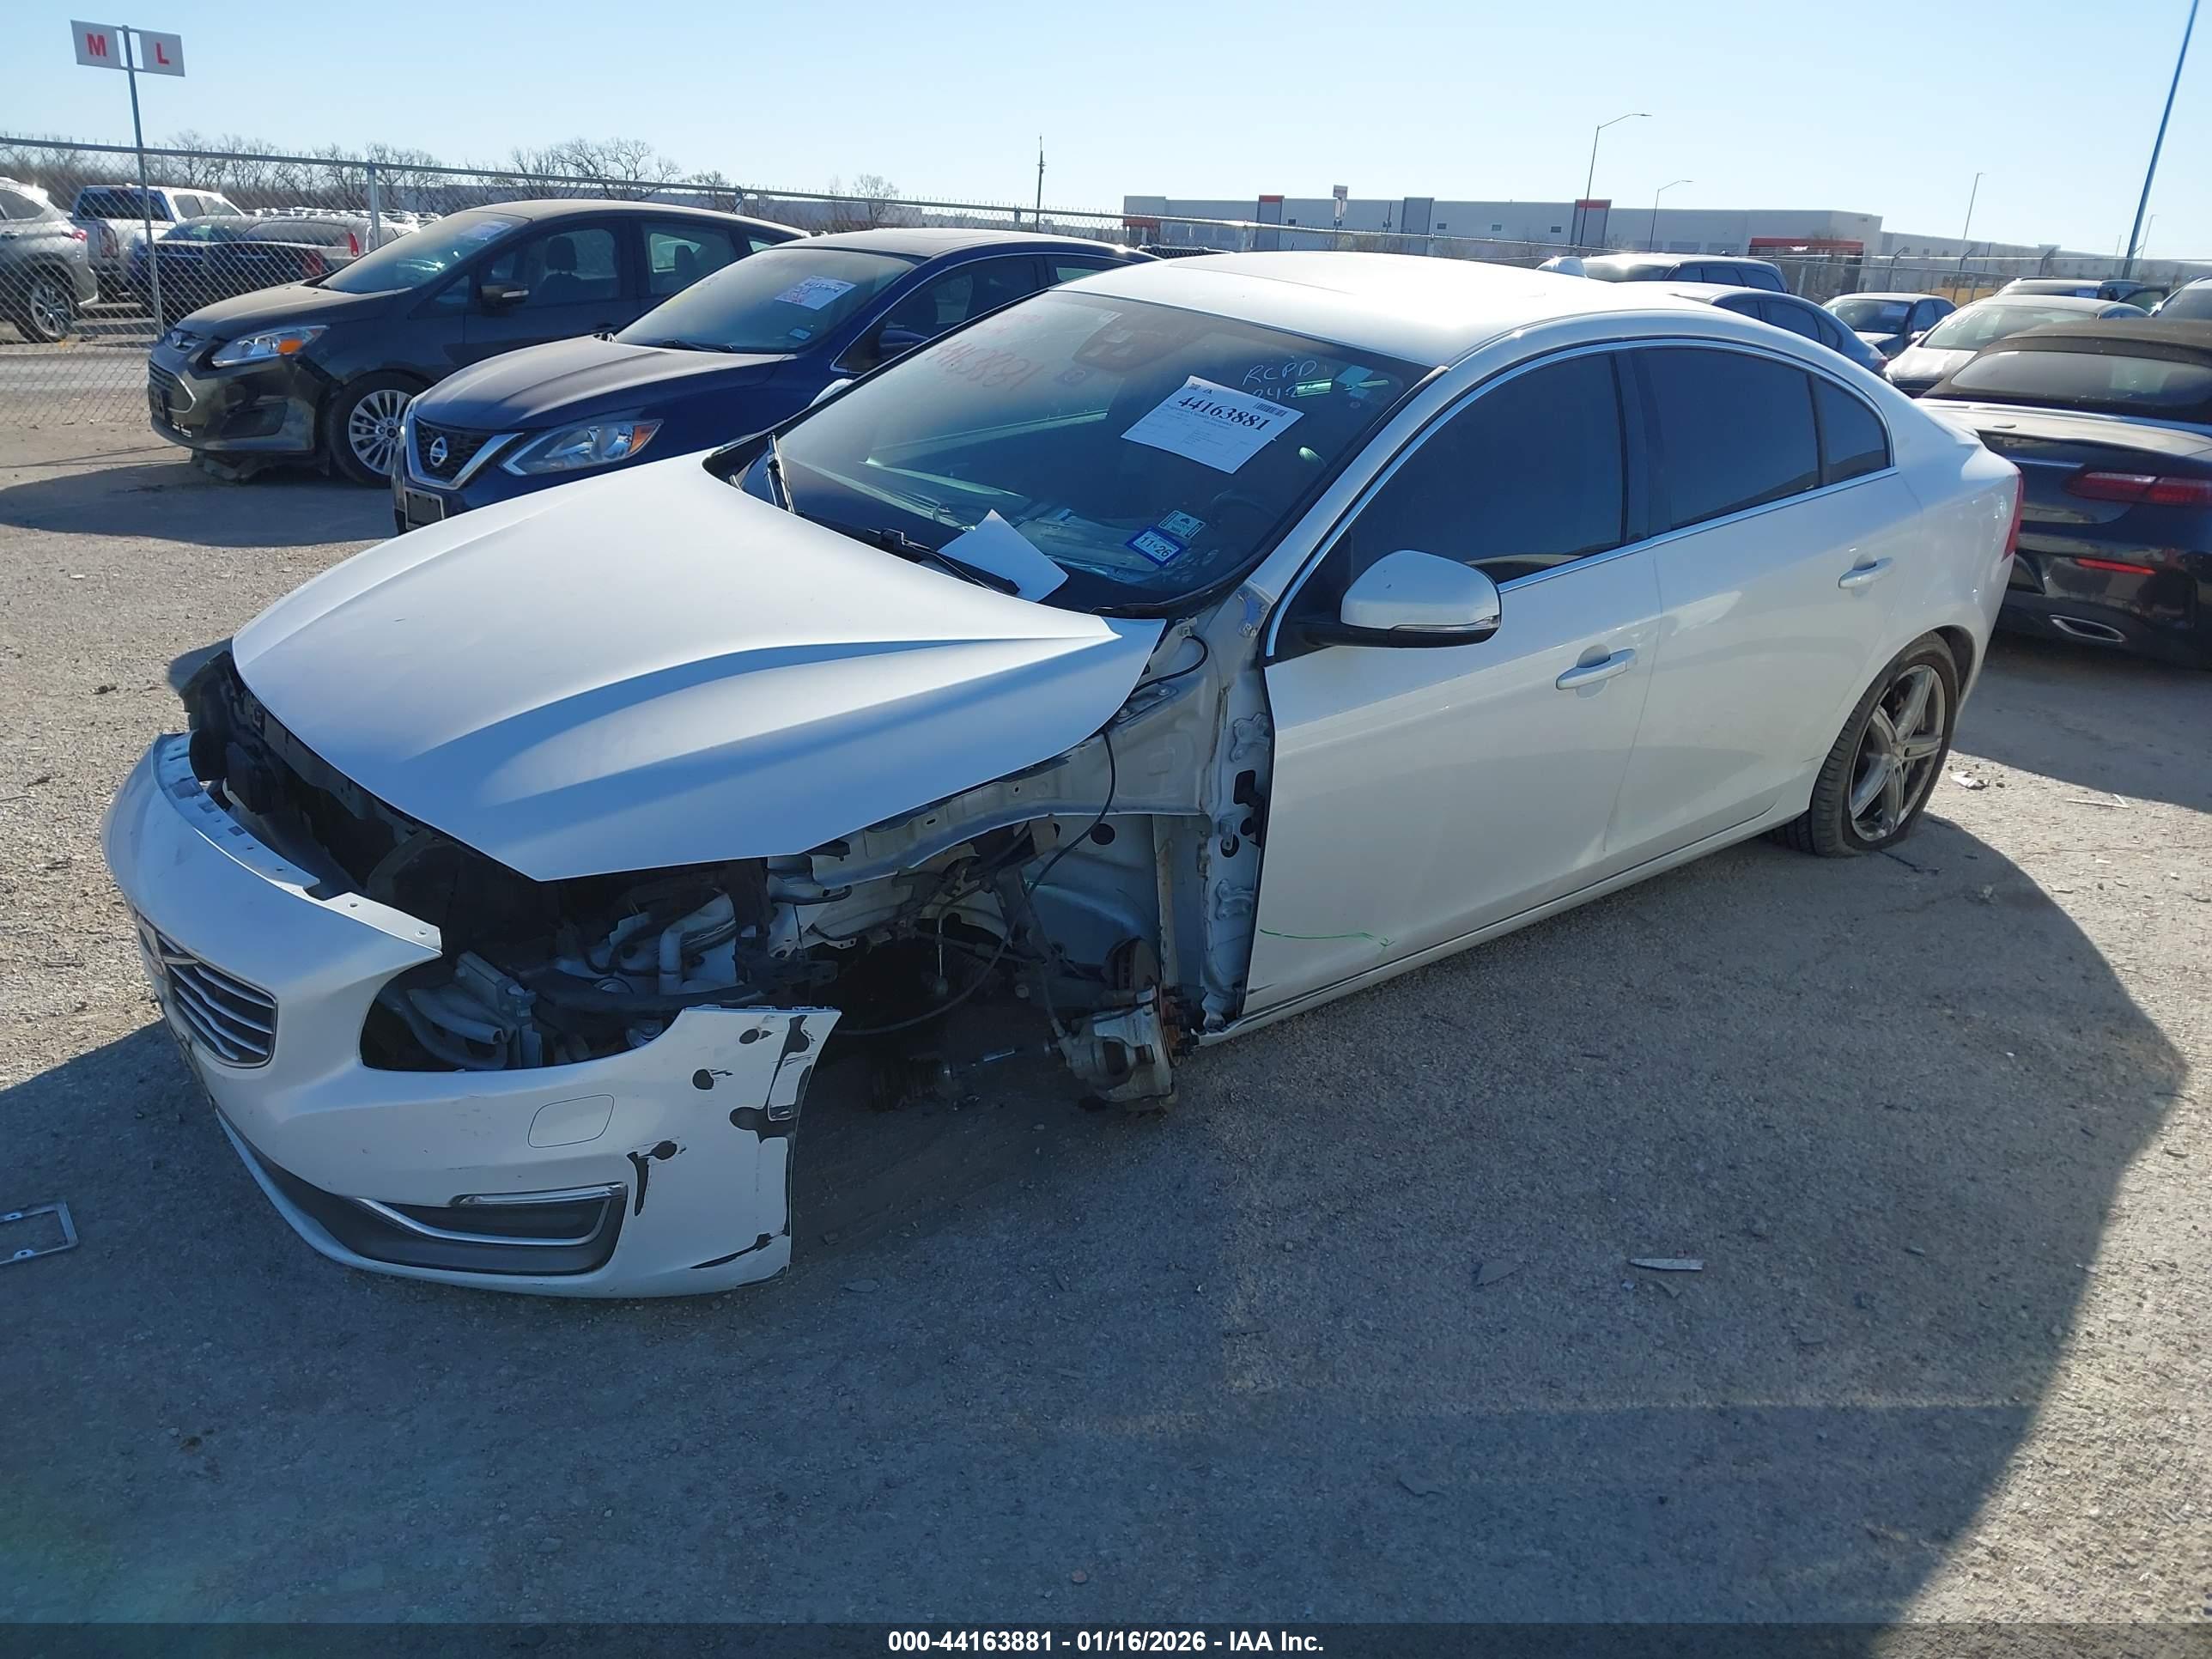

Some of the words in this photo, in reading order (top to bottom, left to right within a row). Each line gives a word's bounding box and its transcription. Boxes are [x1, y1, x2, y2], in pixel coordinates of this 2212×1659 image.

[87, 33, 107, 57] M
[155, 42, 170, 65] L
[1242, 360, 1317, 386] RCPD
[1177, 396, 1272, 431] 44163881
